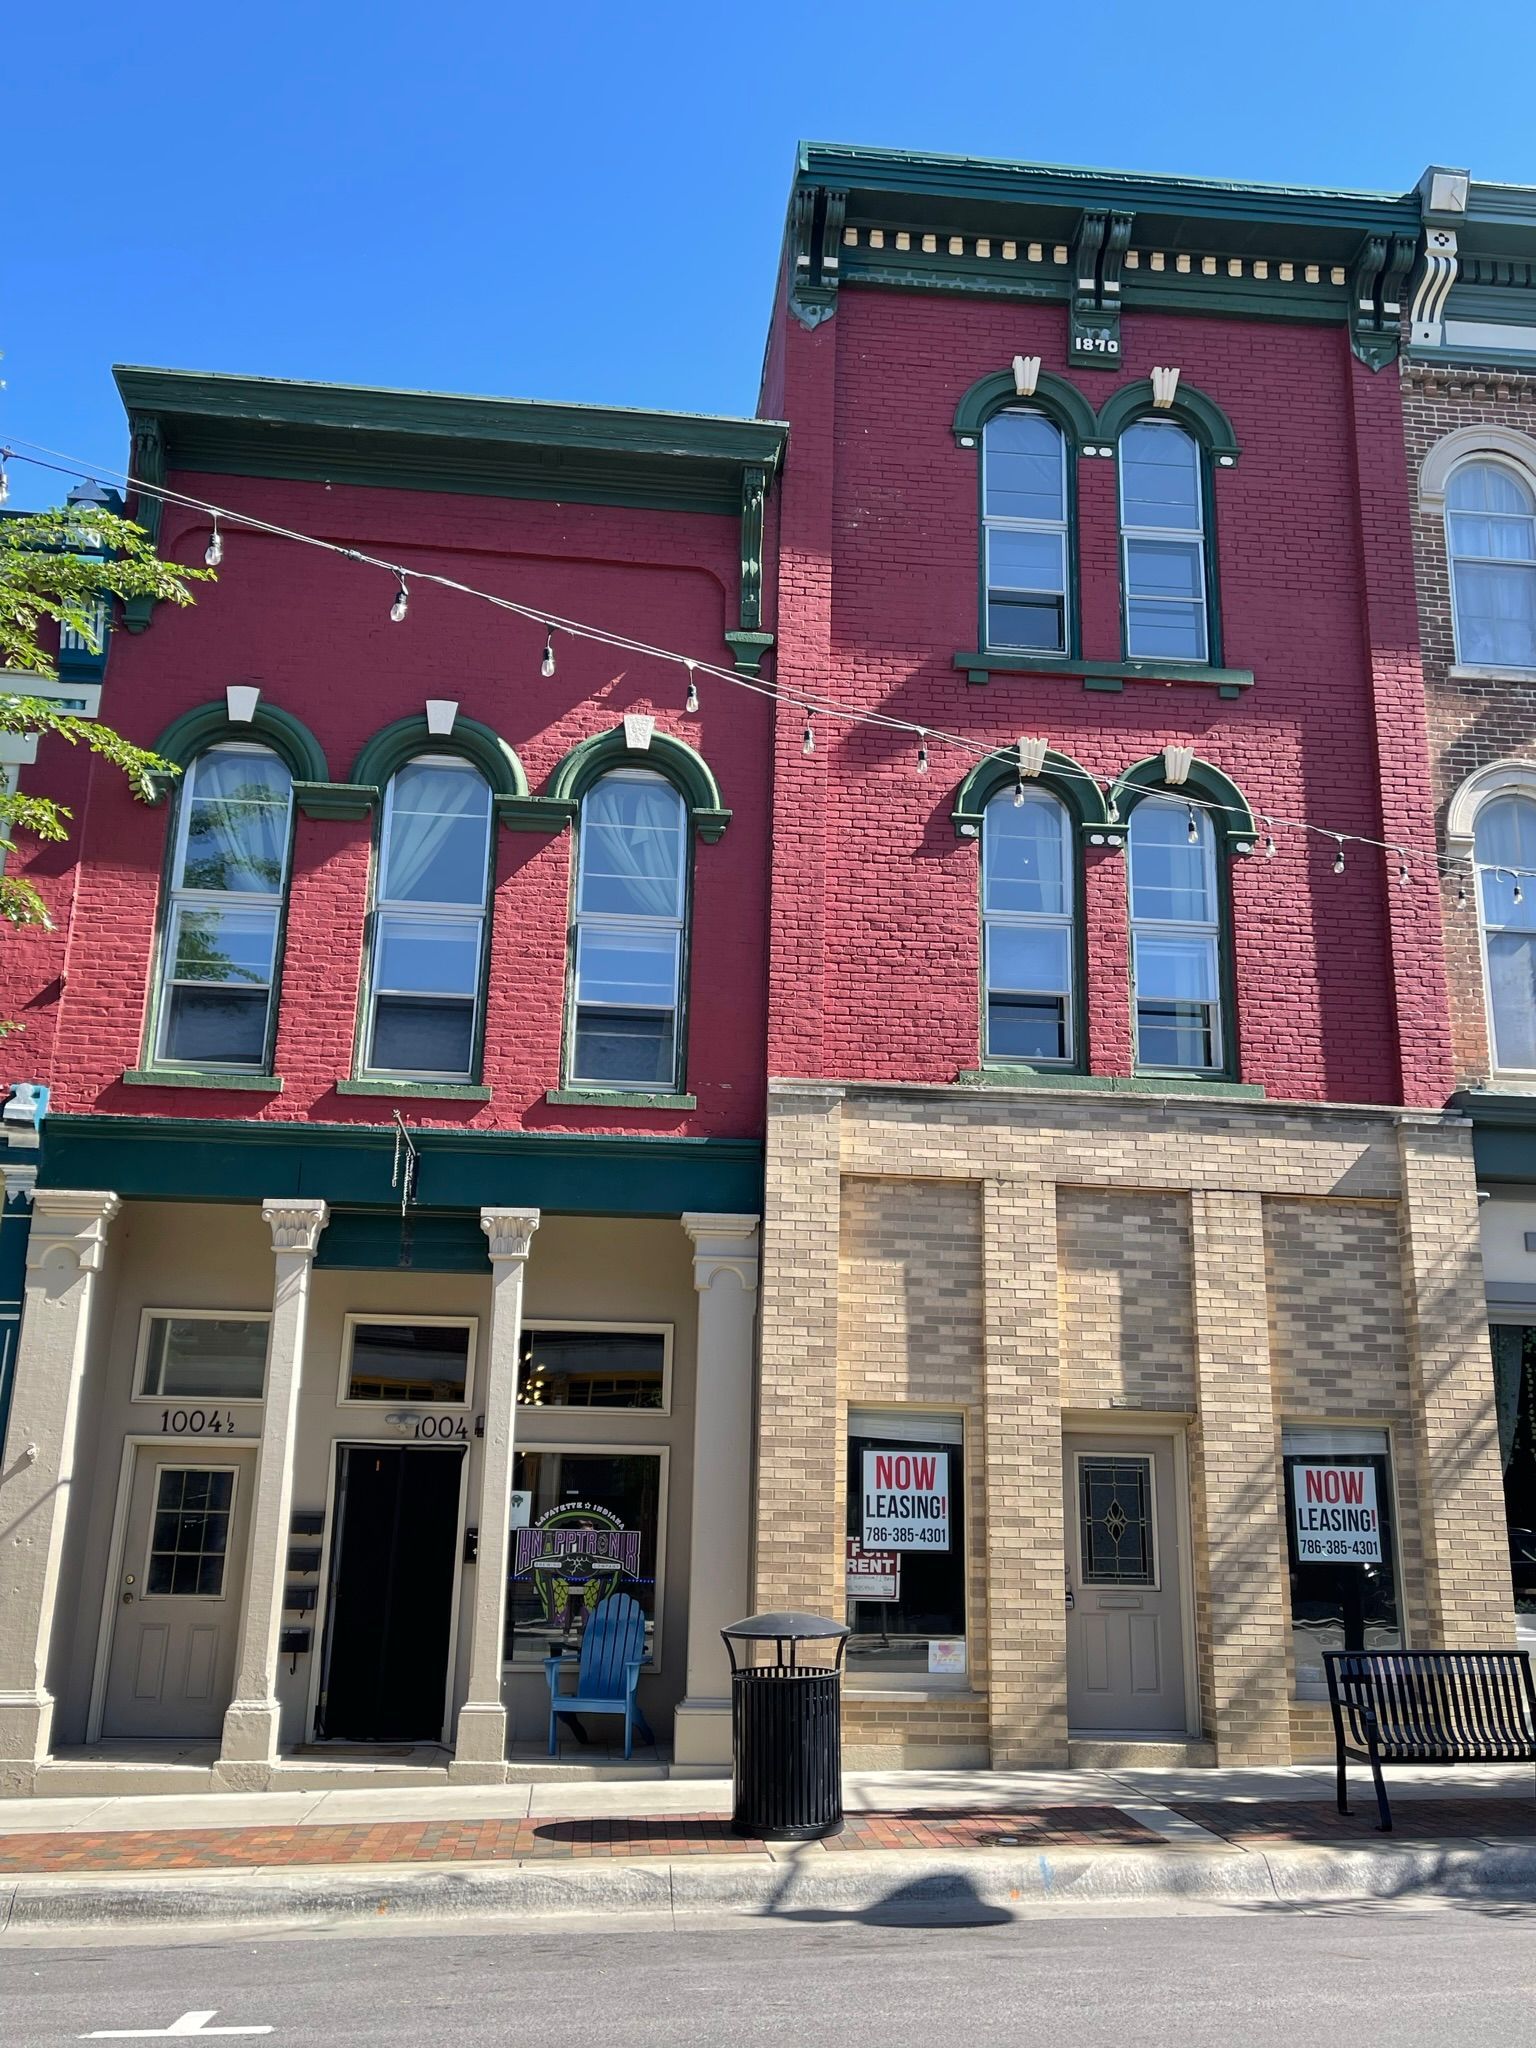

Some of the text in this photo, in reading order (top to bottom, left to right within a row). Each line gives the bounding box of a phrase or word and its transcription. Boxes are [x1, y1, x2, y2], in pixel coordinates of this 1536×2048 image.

[1075, 337, 1118, 353] 1870
[875, 1455, 936, 1490] NOW
[1305, 1470, 1363, 1504] NOW
[534, 1502, 583, 1527] LAFAYETTE
[593, 1504, 625, 1530] INDIANA
[866, 1495, 946, 1519] LEASING!
[1298, 1508, 1377, 1532] LEASING!
[865, 1527, 946, 1543] 786-385-4301
[1300, 1539, 1378, 1555] 786-385-4301
[847, 1558, 895, 1574] RENT
